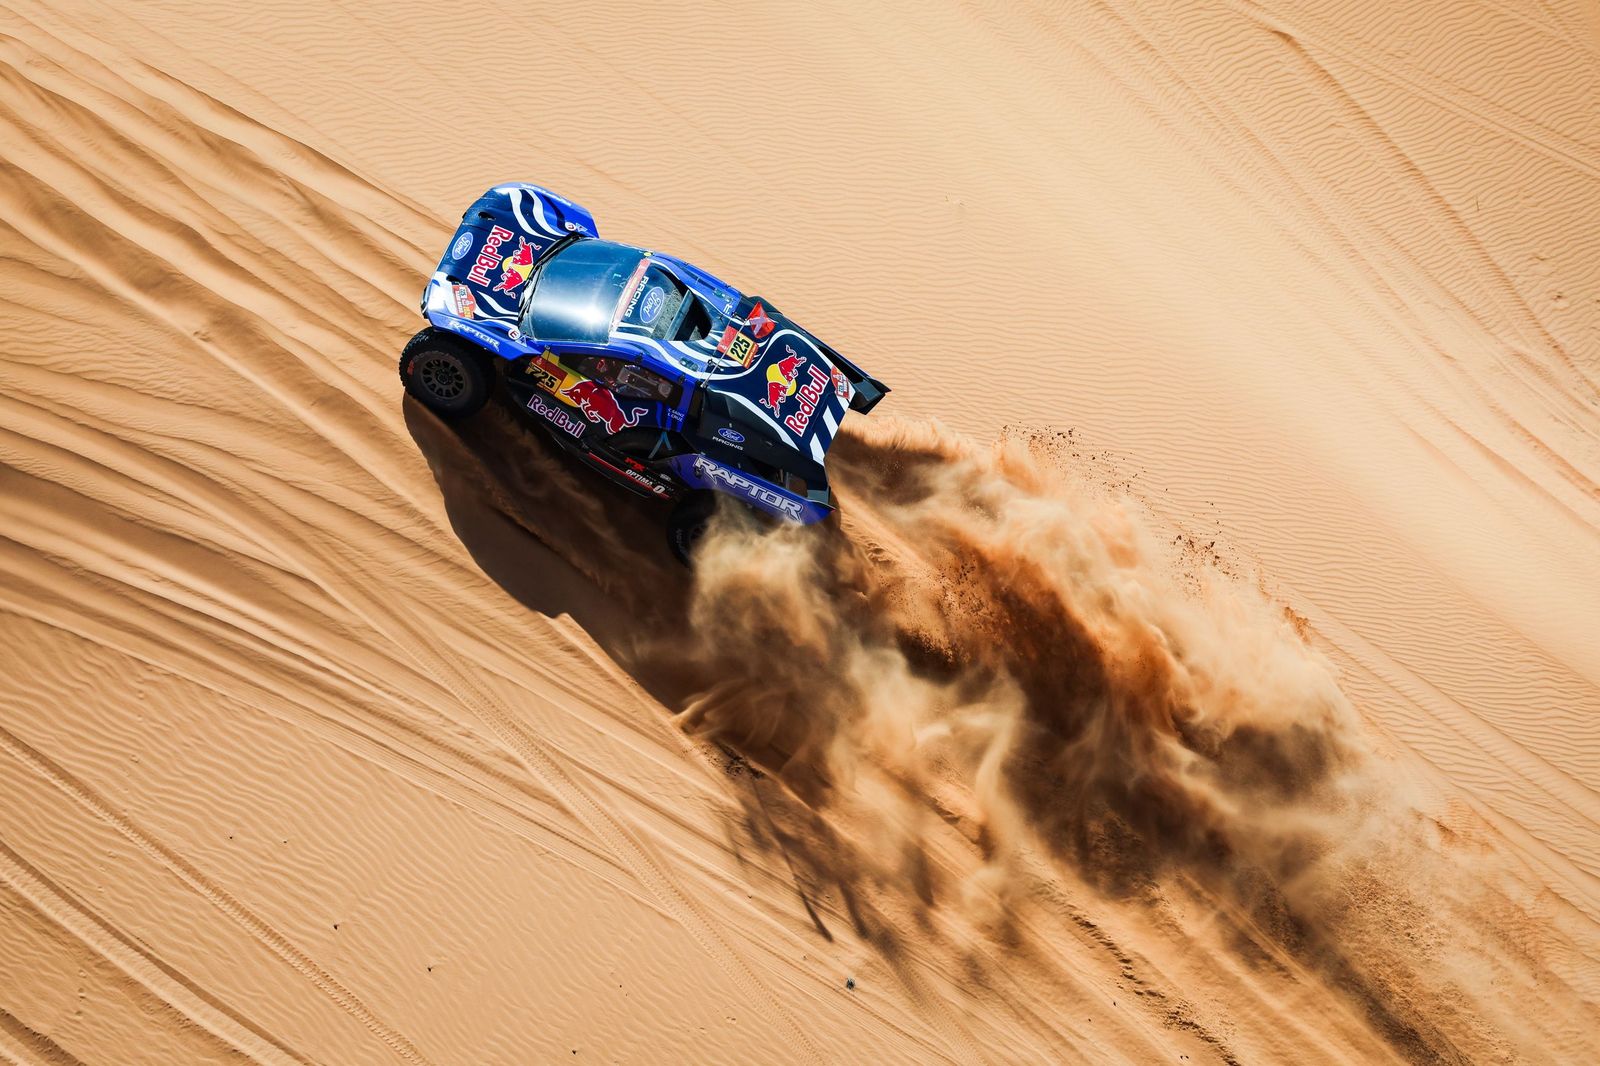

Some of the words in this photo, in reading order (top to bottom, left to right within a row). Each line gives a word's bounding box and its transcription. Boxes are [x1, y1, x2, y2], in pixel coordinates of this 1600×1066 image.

[453, 235, 473, 256] Ford
[624, 276, 649, 318] RACING
[643, 291, 662, 317] Ford
[449, 320, 500, 349] RAPTOR
[730, 336, 751, 361] 225
[712, 436, 744, 450] RACING
[719, 429, 744, 442] Ford
[625, 469, 653, 487] OPTIMA
[693, 457, 803, 521] RAPTOR
